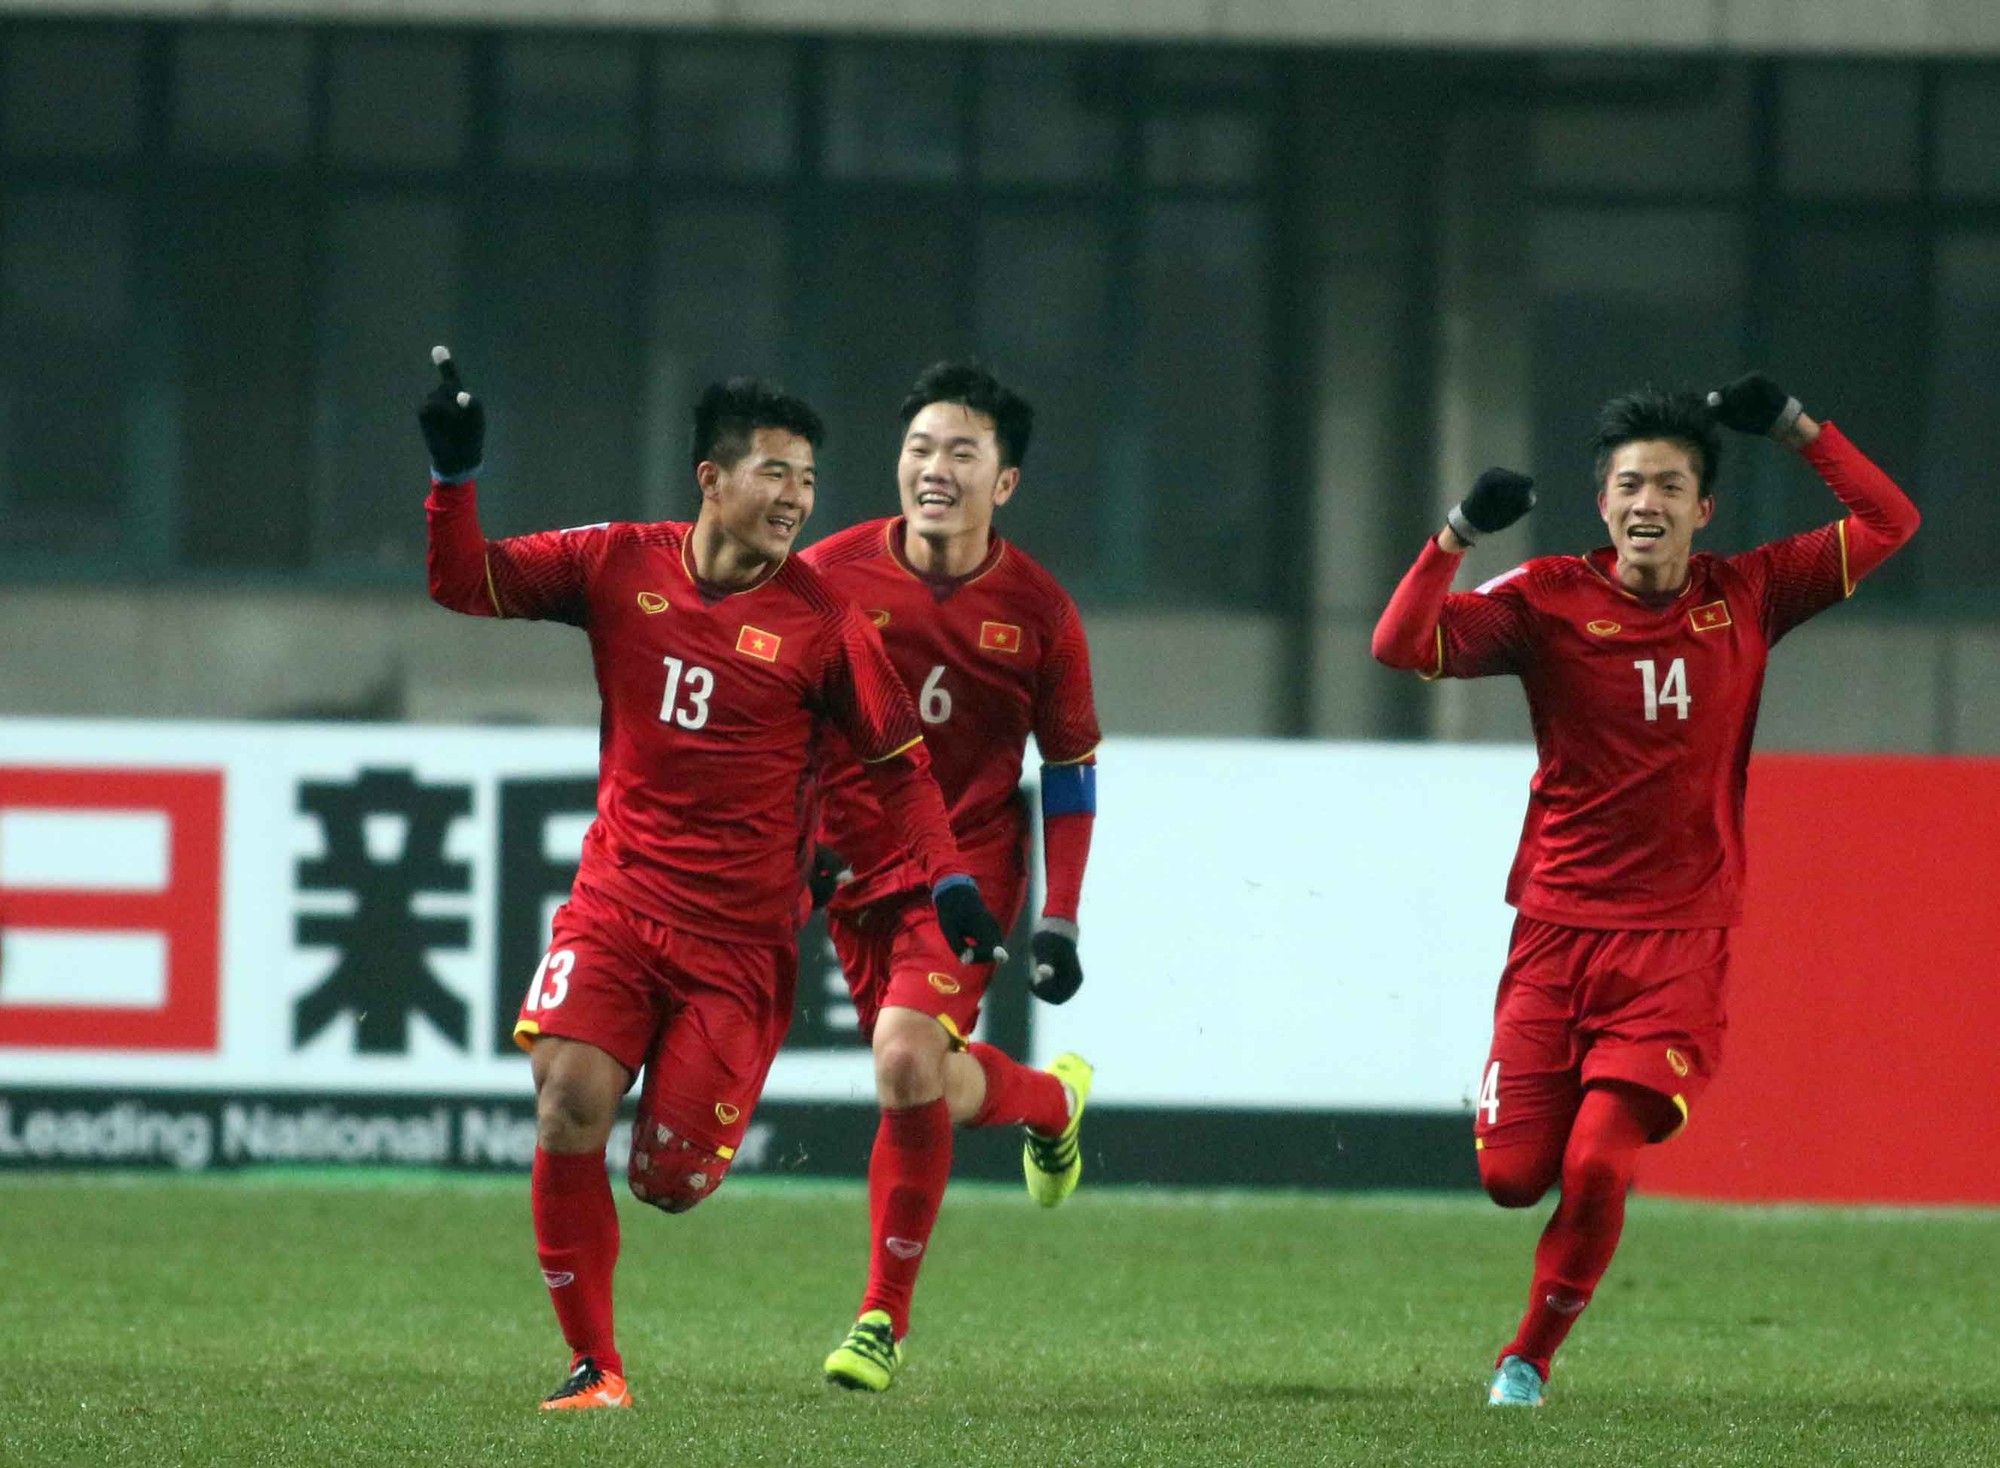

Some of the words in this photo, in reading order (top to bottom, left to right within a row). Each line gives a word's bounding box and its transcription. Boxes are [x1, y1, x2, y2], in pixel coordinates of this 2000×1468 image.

[659, 656, 714, 730] 13
[919, 666, 951, 723] 6
[1633, 658, 1692, 721] 14
[525, 949, 576, 1012] 13
[1476, 1060, 1500, 1125] 4
[0, 1101, 211, 1171] Leading
[222, 1101, 452, 1161] National
